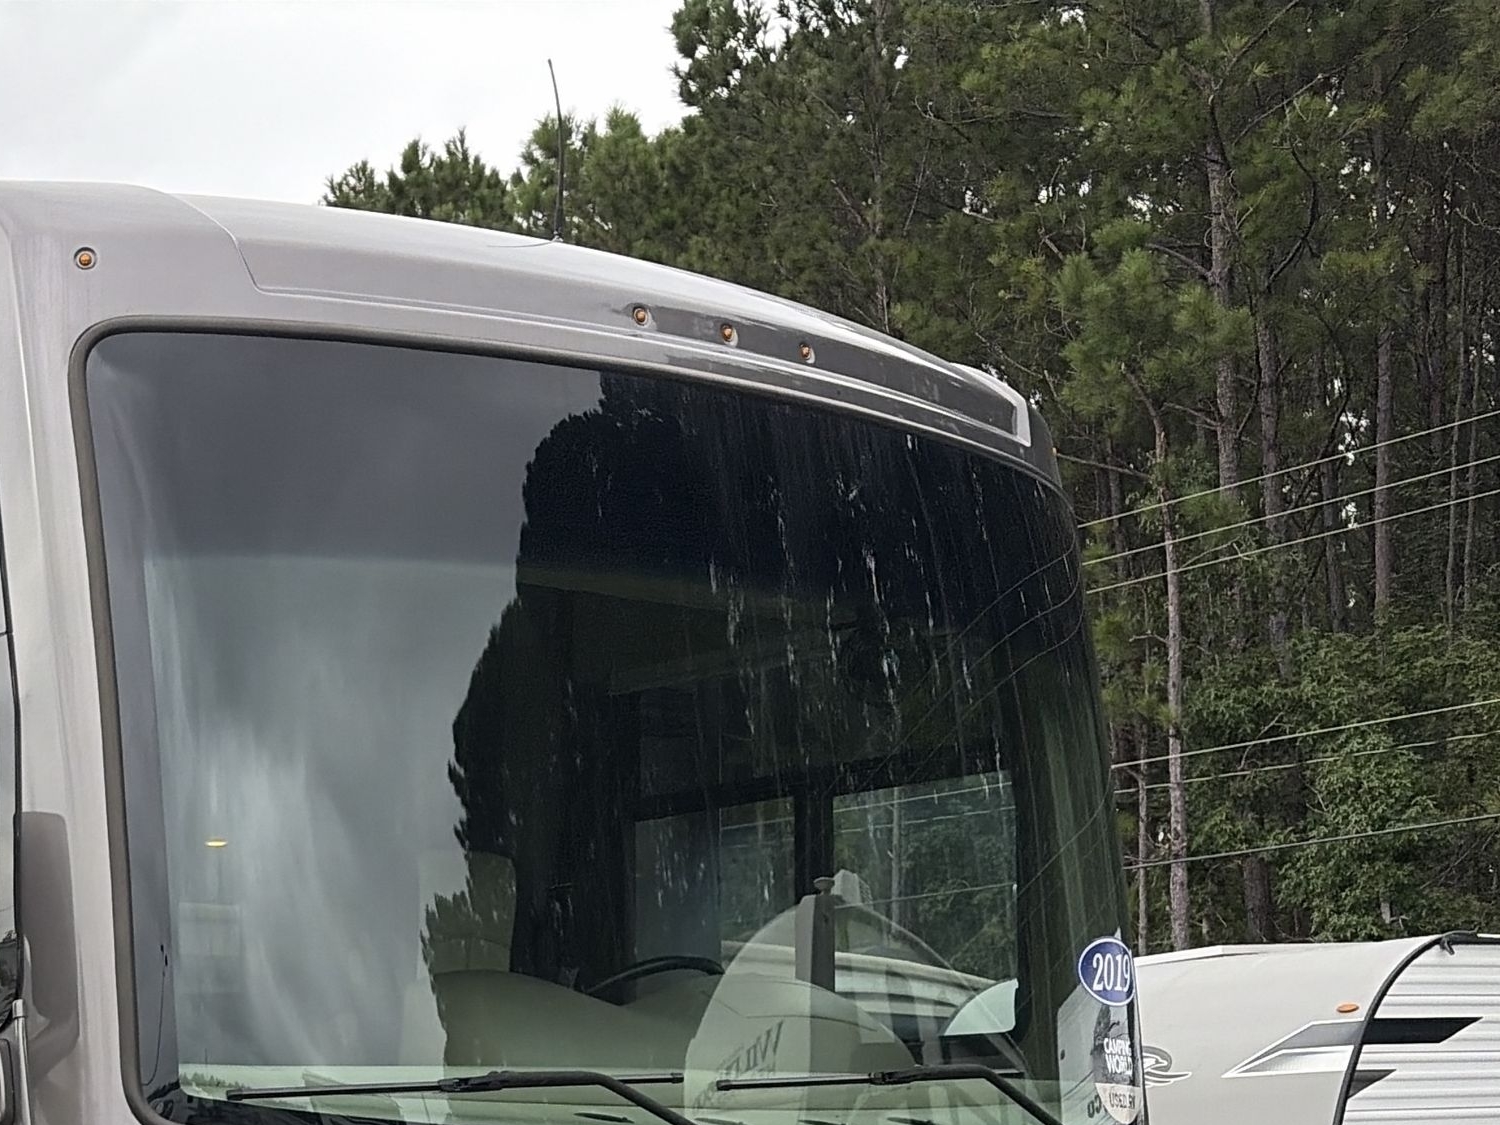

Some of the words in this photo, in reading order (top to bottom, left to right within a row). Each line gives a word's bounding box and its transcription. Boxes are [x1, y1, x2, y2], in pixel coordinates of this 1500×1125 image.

[1092, 952, 1131, 992] 2019
[1103, 1037, 1132, 1058] CAMPING
[1105, 1053, 1134, 1077] WORLD
[1108, 1091, 1127, 1109] USED
